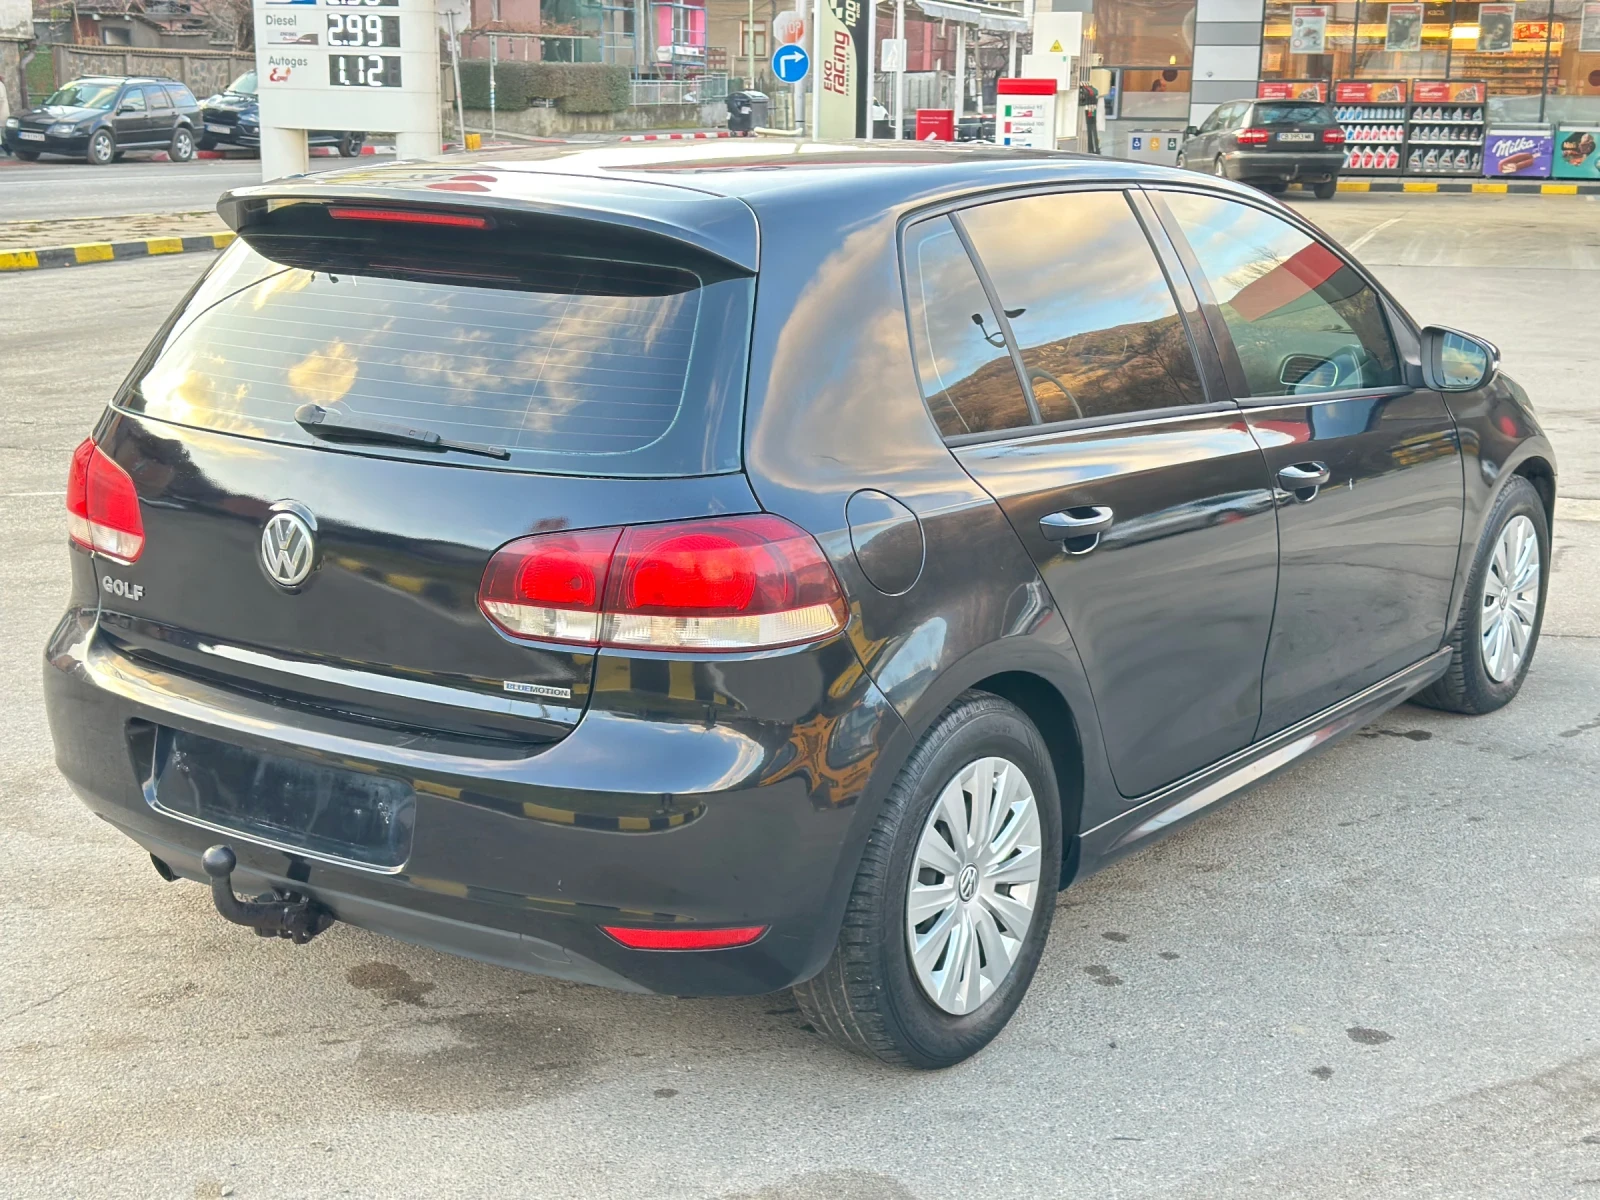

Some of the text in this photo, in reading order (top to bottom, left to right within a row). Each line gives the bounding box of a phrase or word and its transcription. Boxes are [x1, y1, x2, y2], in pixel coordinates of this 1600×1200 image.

[266, 14, 383, 47] Diesel 2.99
[269, 55, 384, 86] Autogas 1.12
[824, 60, 832, 91] EKO
[833, 31, 850, 95] racing
[1492, 137, 1536, 157] Milka
[102, 575, 144, 601] GOLF
[506, 682, 569, 697] BLUEMOTION
